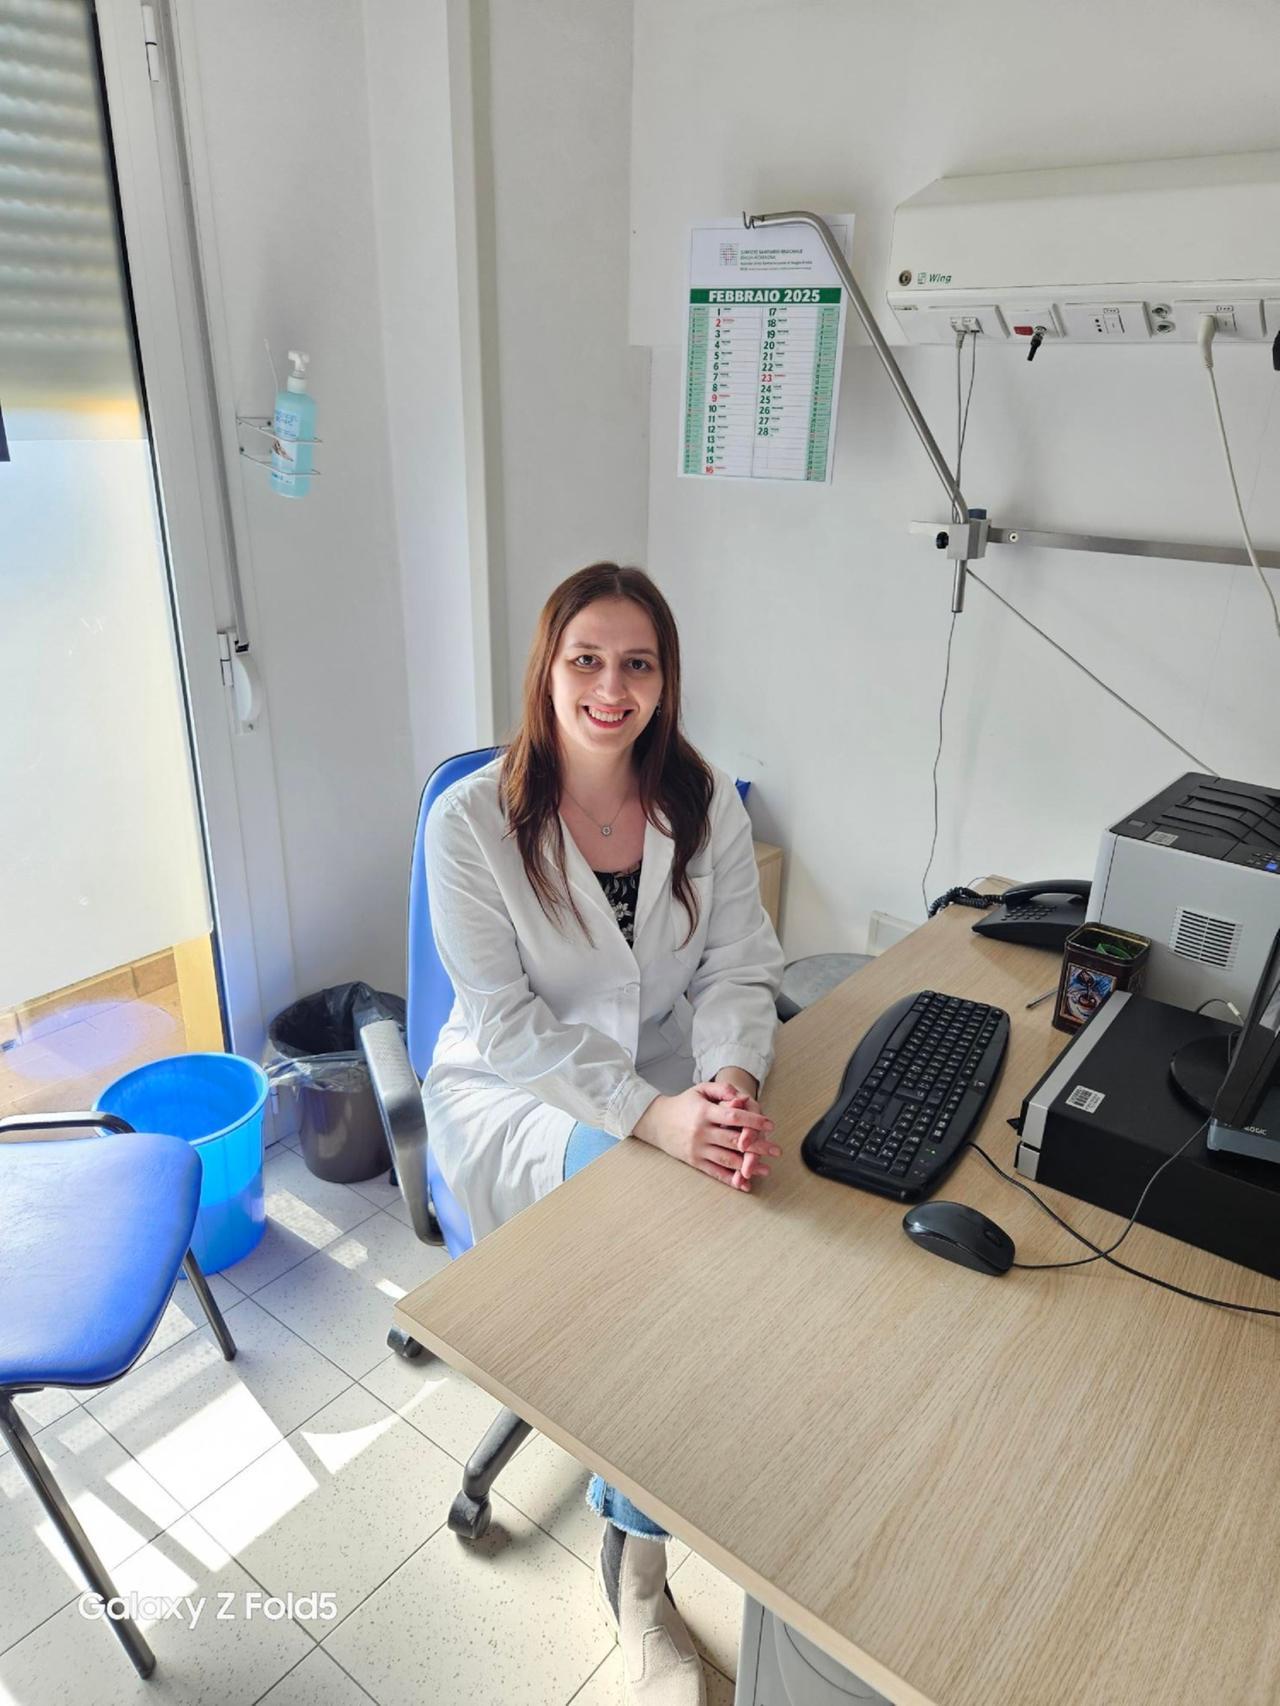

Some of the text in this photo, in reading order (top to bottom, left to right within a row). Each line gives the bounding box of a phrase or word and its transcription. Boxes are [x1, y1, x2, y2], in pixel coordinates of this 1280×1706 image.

[930, 274, 952, 284] Wing
[708, 289, 820, 302] FEBBRAIO 2025
[718, 308, 720, 316] 1
[769, 308, 777, 316] 17
[716, 319, 720, 327] 2
[768, 319, 776, 327] 18
[715, 330, 720, 338] 3
[767, 330, 775, 339] 19
[764, 341, 775, 350] 20
[714, 352, 719, 360] 5
[763, 352, 772, 360] 21
[713, 362, 719, 370] 6
[762, 363, 773, 371] 22
[713, 373, 718, 381] 7
[761, 374, 772, 382] 23
[712, 383, 717, 392] 8
[761, 385, 772, 393] 24
[712, 394, 717, 402] 9
[760, 395, 771, 404] 25
[758, 427, 768, 436] 28
